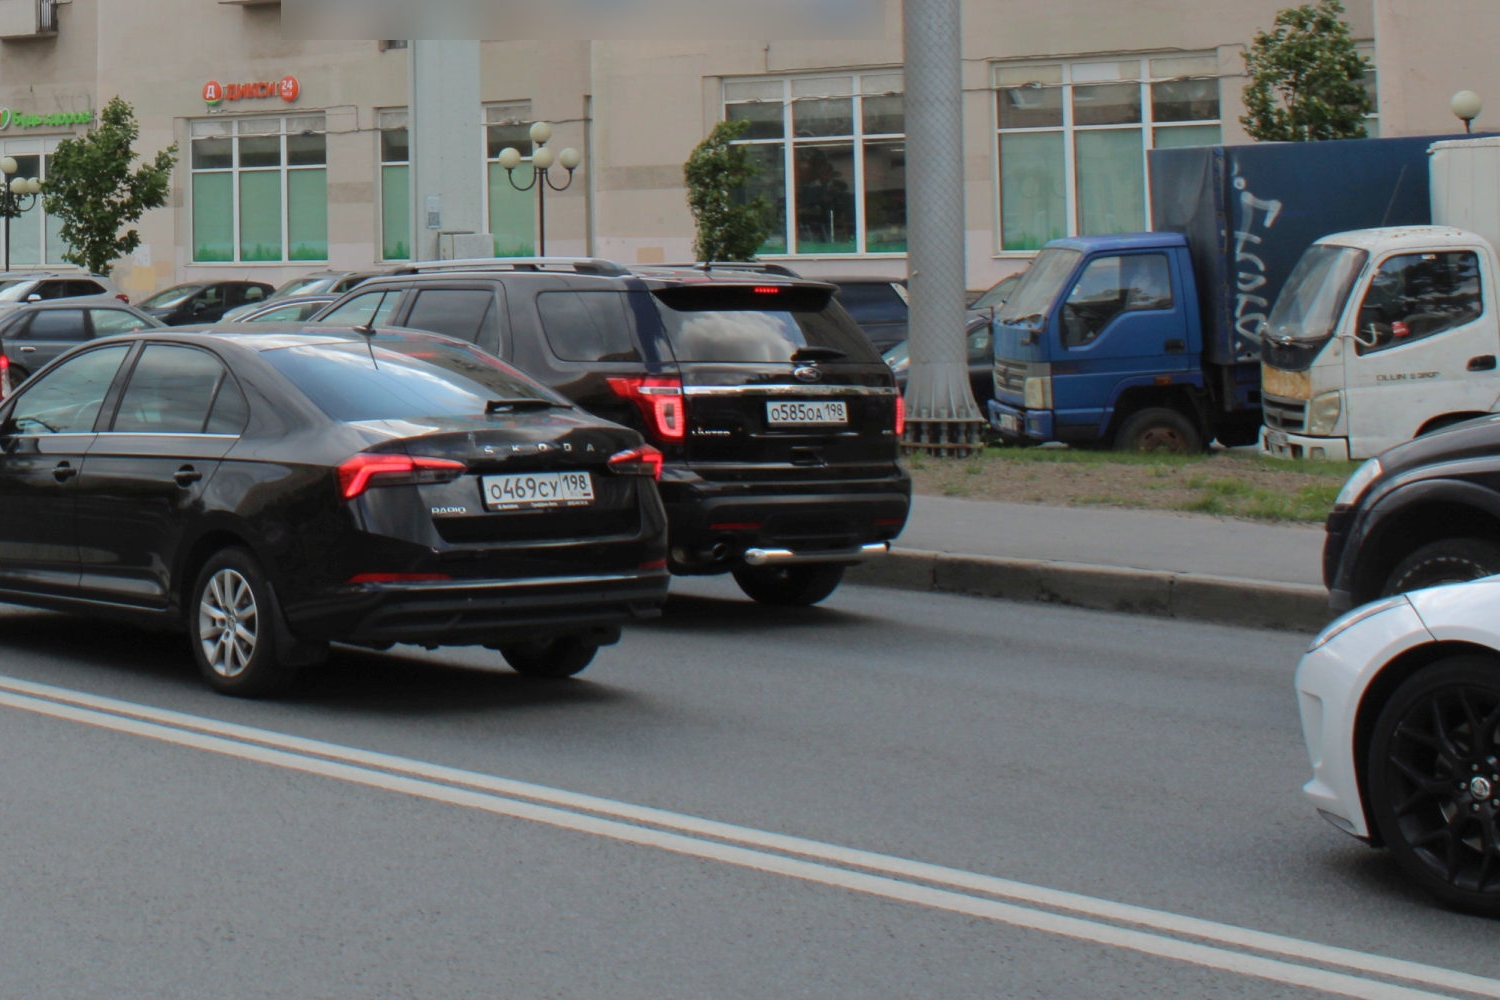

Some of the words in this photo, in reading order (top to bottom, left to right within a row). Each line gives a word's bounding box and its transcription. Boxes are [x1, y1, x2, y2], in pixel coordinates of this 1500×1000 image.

[226, 82, 276, 101] ДИКСИ
[281, 80, 293, 90] 24
[771, 404, 823, 421] О585ОА
[825, 403, 843, 416] 198
[490, 477, 558, 501] О469СУ
[562, 474, 587, 490] 198
